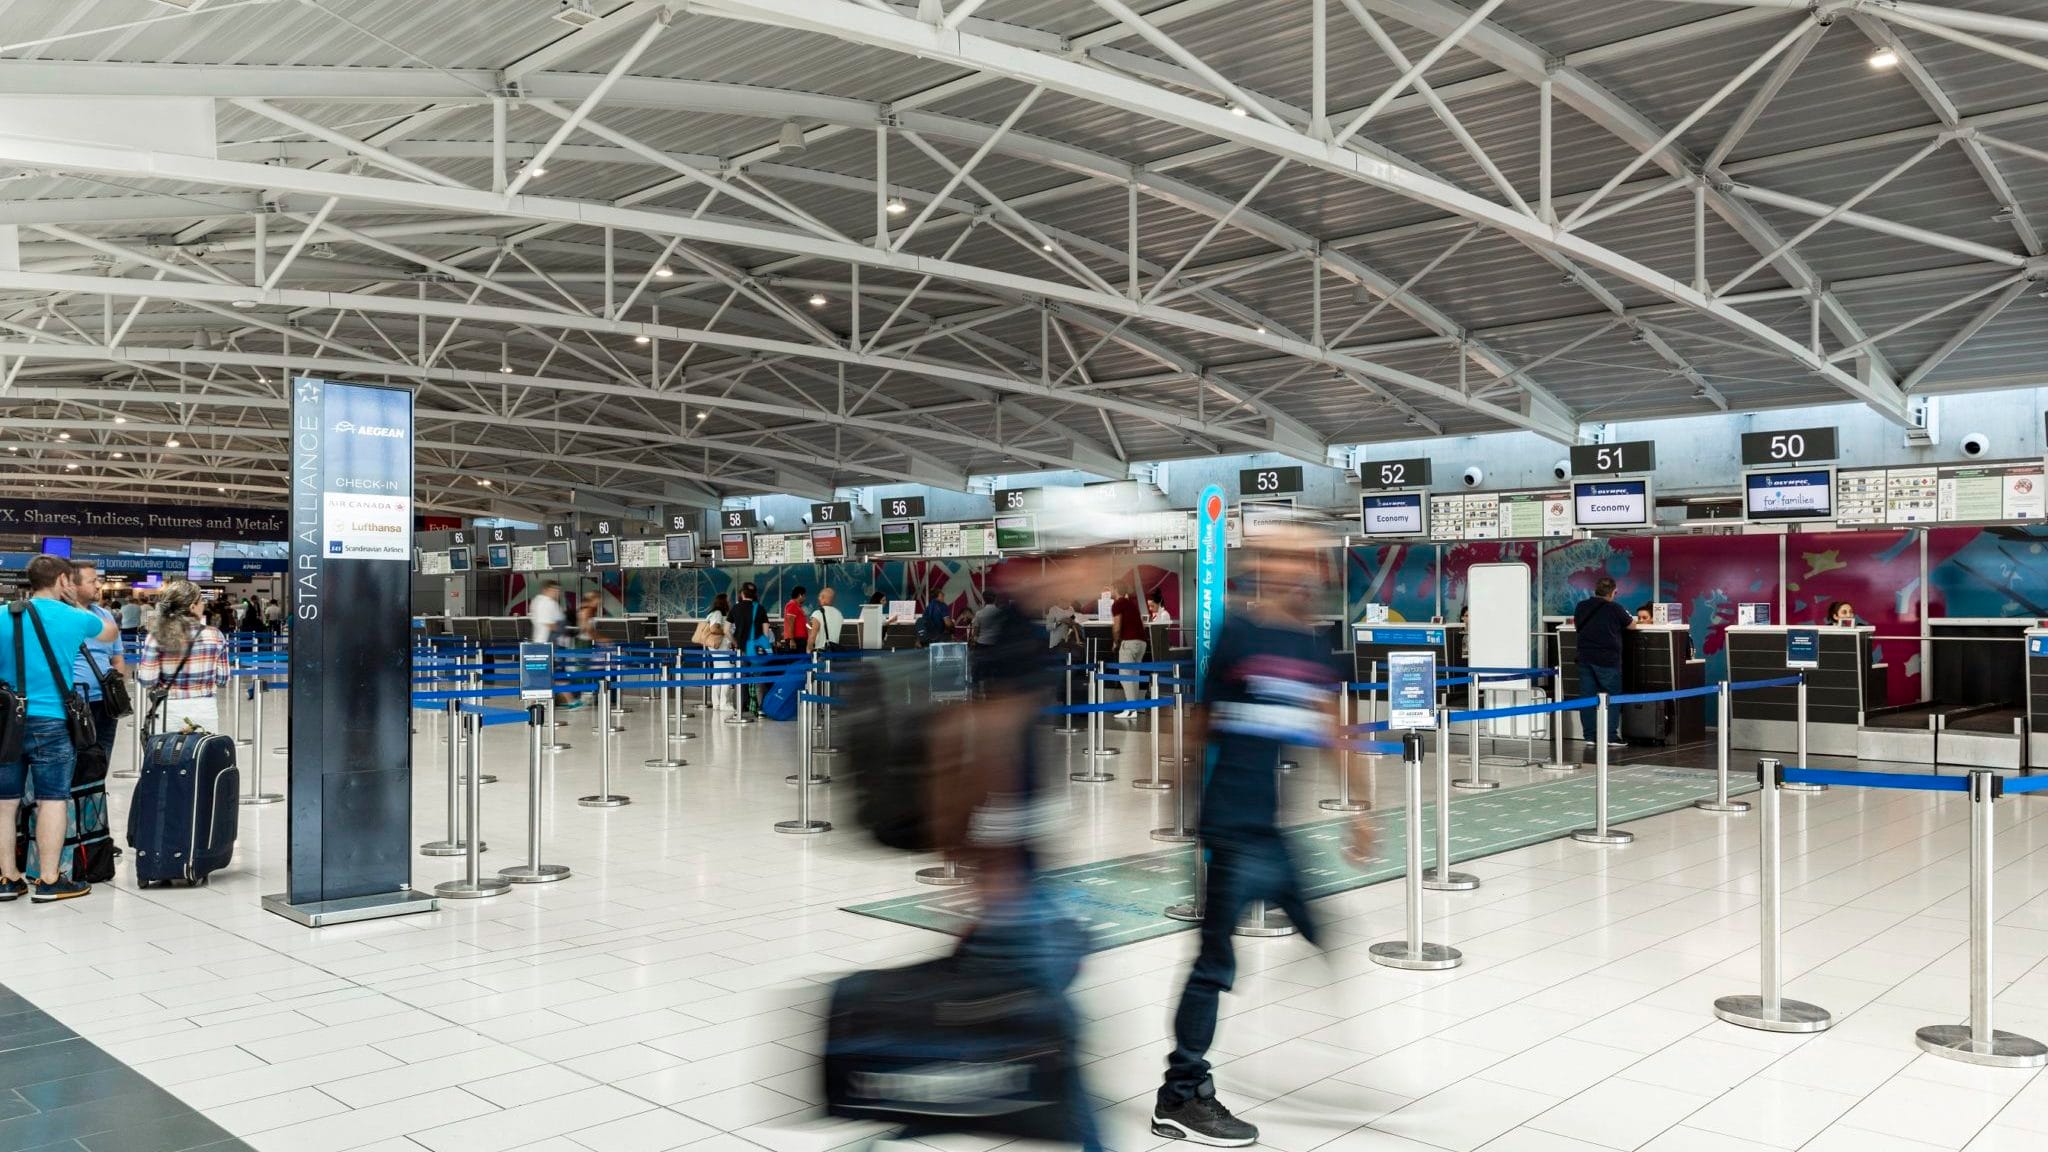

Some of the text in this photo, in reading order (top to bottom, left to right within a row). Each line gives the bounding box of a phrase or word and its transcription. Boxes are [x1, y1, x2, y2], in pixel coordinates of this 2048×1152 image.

[358, 425, 405, 439] AEGEAN
[1770, 434, 1805, 459] 50
[1597, 447, 1623, 470] 51
[1257, 471, 1279, 491] 53
[1381, 464, 1405, 484] 52
[335, 477, 399, 490] CHECK-IN
[328, 499, 392, 510] AIR CANADA
[1007, 491, 1024, 508] 55
[1763, 492, 1815, 506] for families
[821, 506, 834, 520] 57
[891, 500, 907, 516] 56
[1590, 504, 1631, 513] Economy
[24, 509, 81, 526] Shares,
[86, 512, 144, 527] Indices,
[148, 514, 203, 528] Futures
[206, 517, 232, 529] and
[298, 416, 319, 620] STAR ALLIANCE
[673, 516, 685, 530] 59
[729, 513, 742, 527] 58
[1376, 515, 1409, 523] Economy
[351, 521, 402, 533] Lufthansa
[553, 525, 563, 537] 61
[599, 522, 609, 535] 60
[455, 532, 464, 543] 63
[494, 530, 503, 541] 62
[1202, 523, 1216, 650] AEGEAN for families
